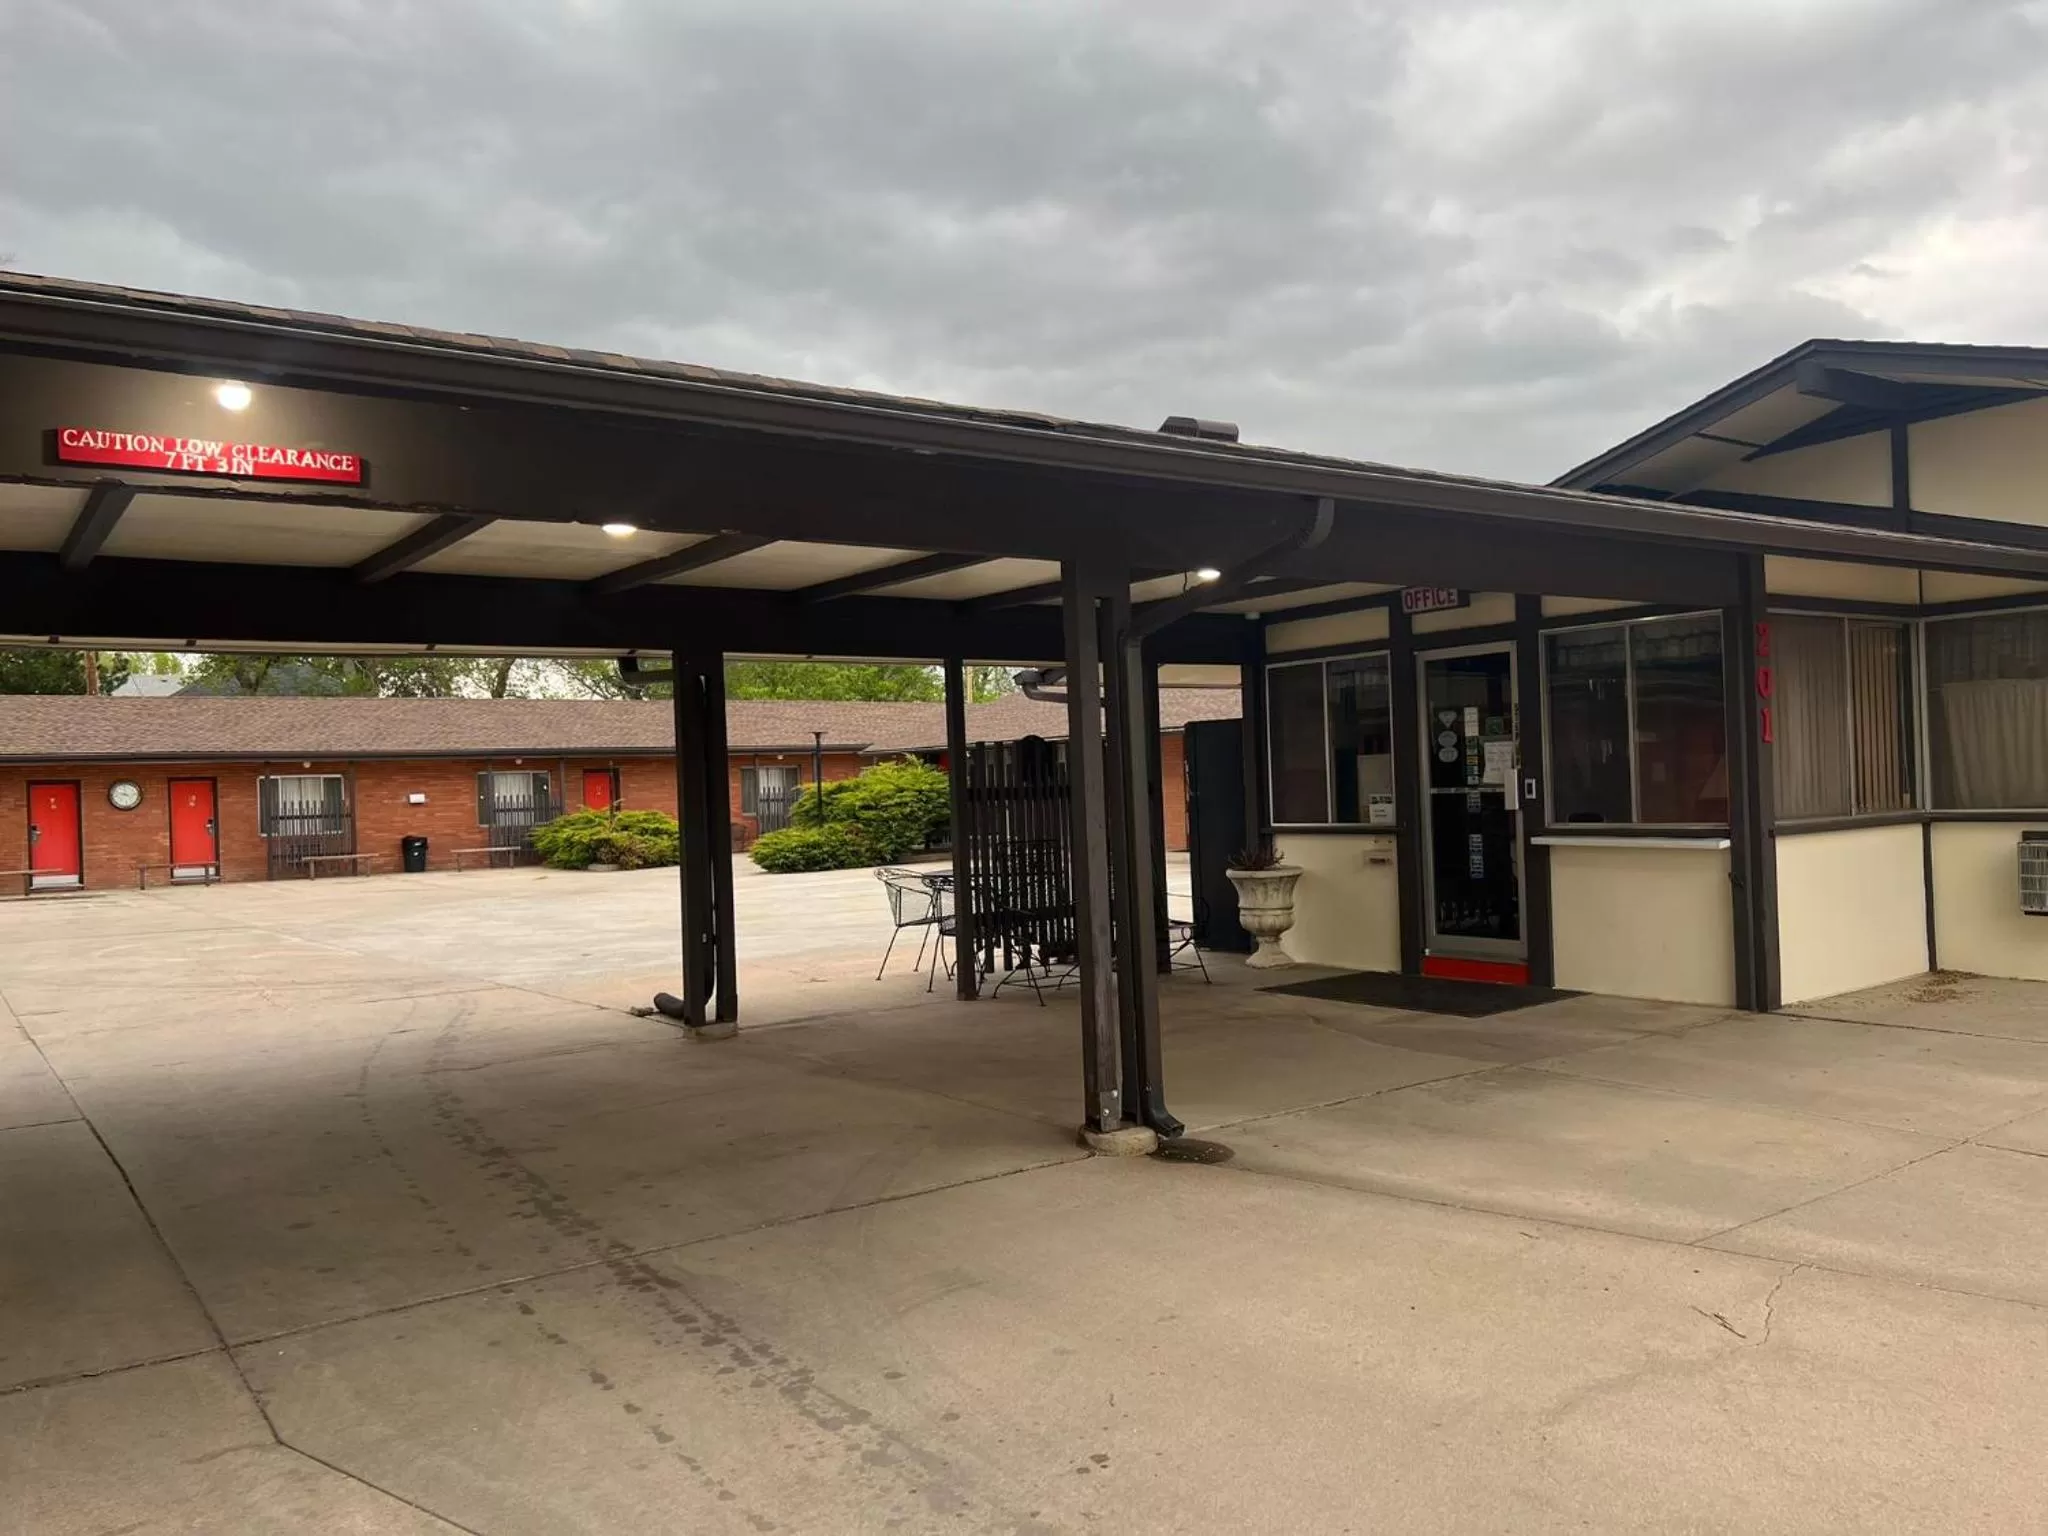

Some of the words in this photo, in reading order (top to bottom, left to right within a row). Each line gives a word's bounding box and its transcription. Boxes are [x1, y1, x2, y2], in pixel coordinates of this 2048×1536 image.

[63, 429, 165, 453] CAUTION
[175, 438, 224, 457] LOW
[231, 444, 355, 471] CLEARANCE
[165, 451, 176, 469] 7
[182, 454, 210, 472] FT
[217, 455, 229, 473] 3
[232, 458, 255, 475] IN
[1404, 587, 1457, 610] OFFICE
[1755, 623, 1775, 744] 201
